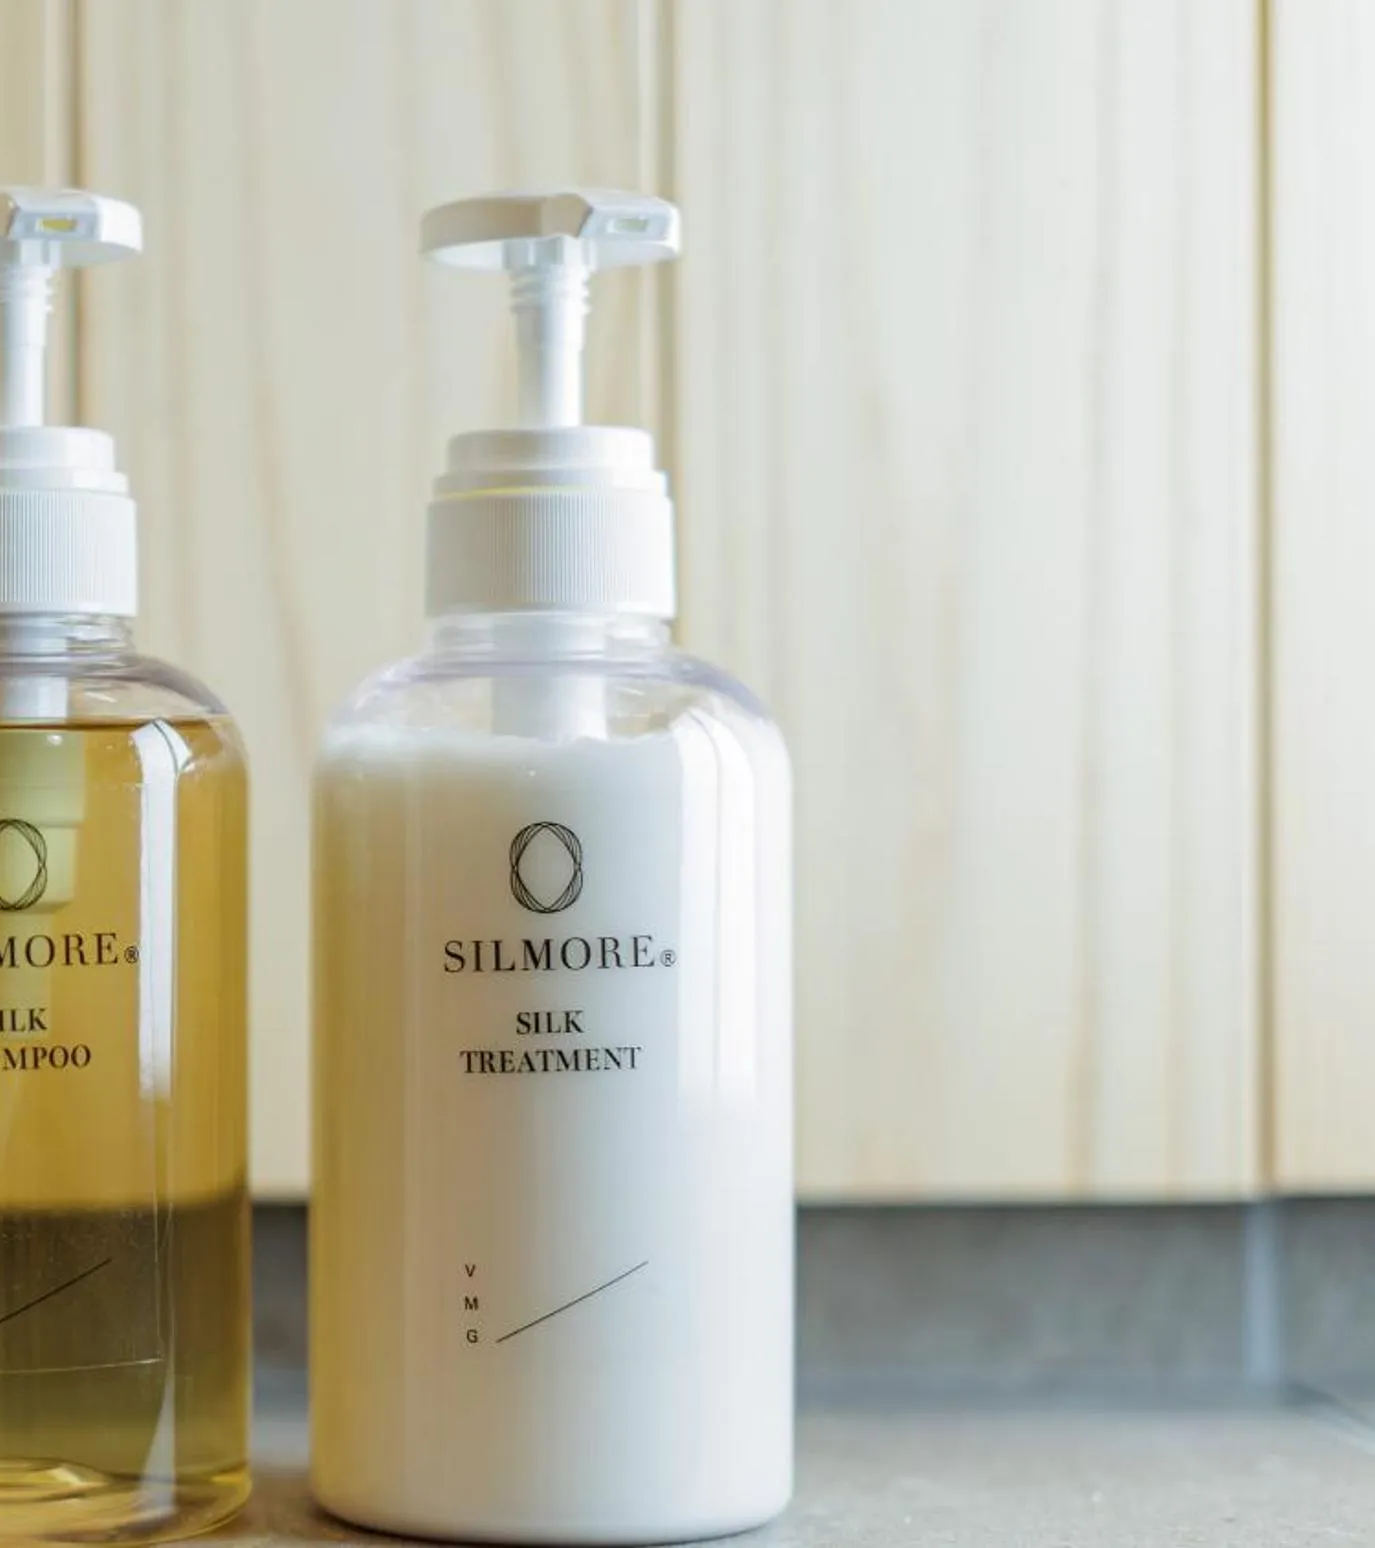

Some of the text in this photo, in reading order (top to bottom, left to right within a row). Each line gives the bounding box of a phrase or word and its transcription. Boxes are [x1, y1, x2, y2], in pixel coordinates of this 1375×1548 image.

[516, 1010, 584, 1035] SILK
[460, 1047, 641, 1074] TREATMENT
[464, 1264, 476, 1277] V
[464, 1297, 479, 1310] M
[466, 1330, 479, 1344] G
